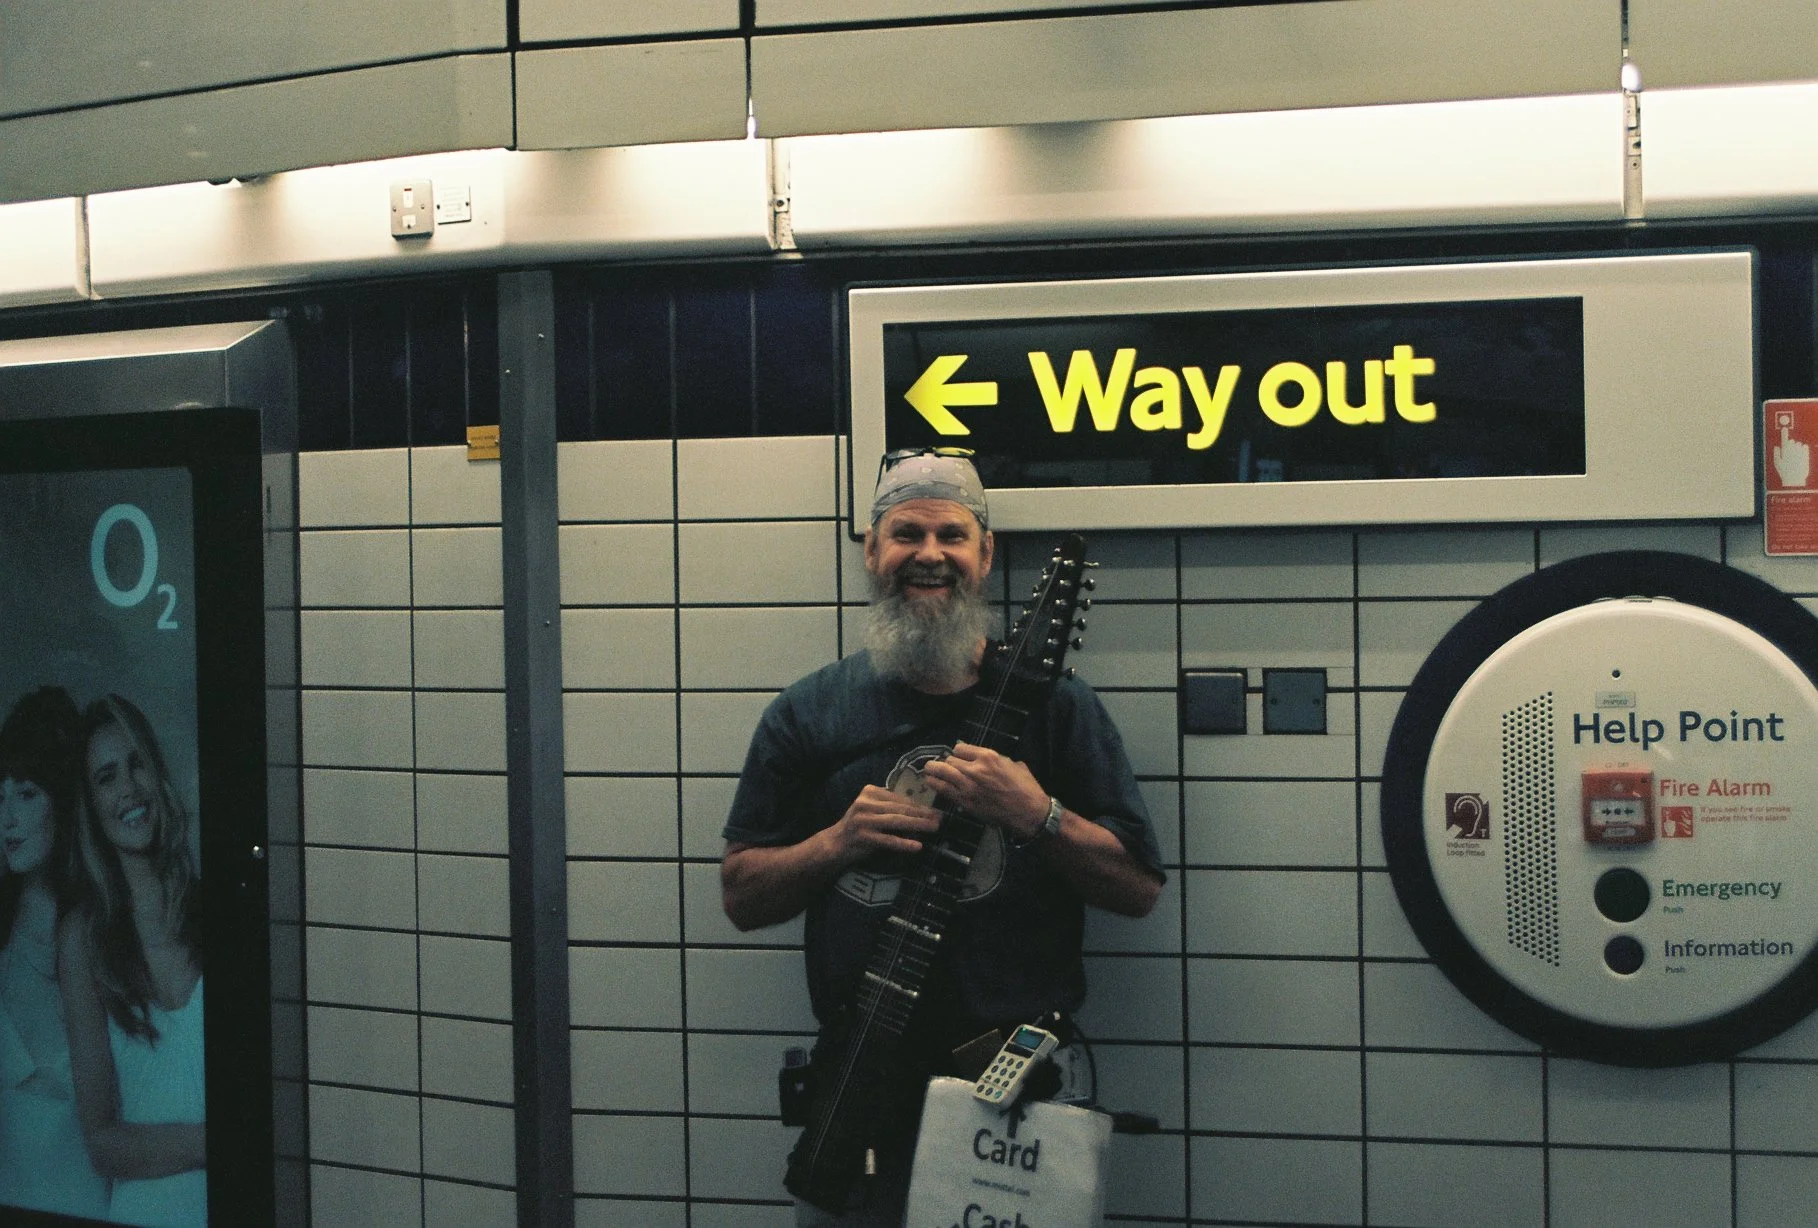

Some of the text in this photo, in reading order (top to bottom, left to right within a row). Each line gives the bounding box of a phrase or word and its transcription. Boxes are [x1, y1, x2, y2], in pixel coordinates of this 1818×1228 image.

[1027, 344, 1437, 450] Way out
[1573, 709, 1785, 751] Help Point
[1660, 779, 1771, 796] Fire Alarm
[1733, 814, 1748, 822] this
[1750, 814, 1764, 822] fire
[1765, 814, 1787, 822] alarm
[1662, 879, 1782, 901] Emergency
[1662, 905, 1684, 914] Push
[1664, 938, 1794, 958] Information
[1665, 965, 1686, 974] Push
[973, 1128, 1041, 1173] Card
